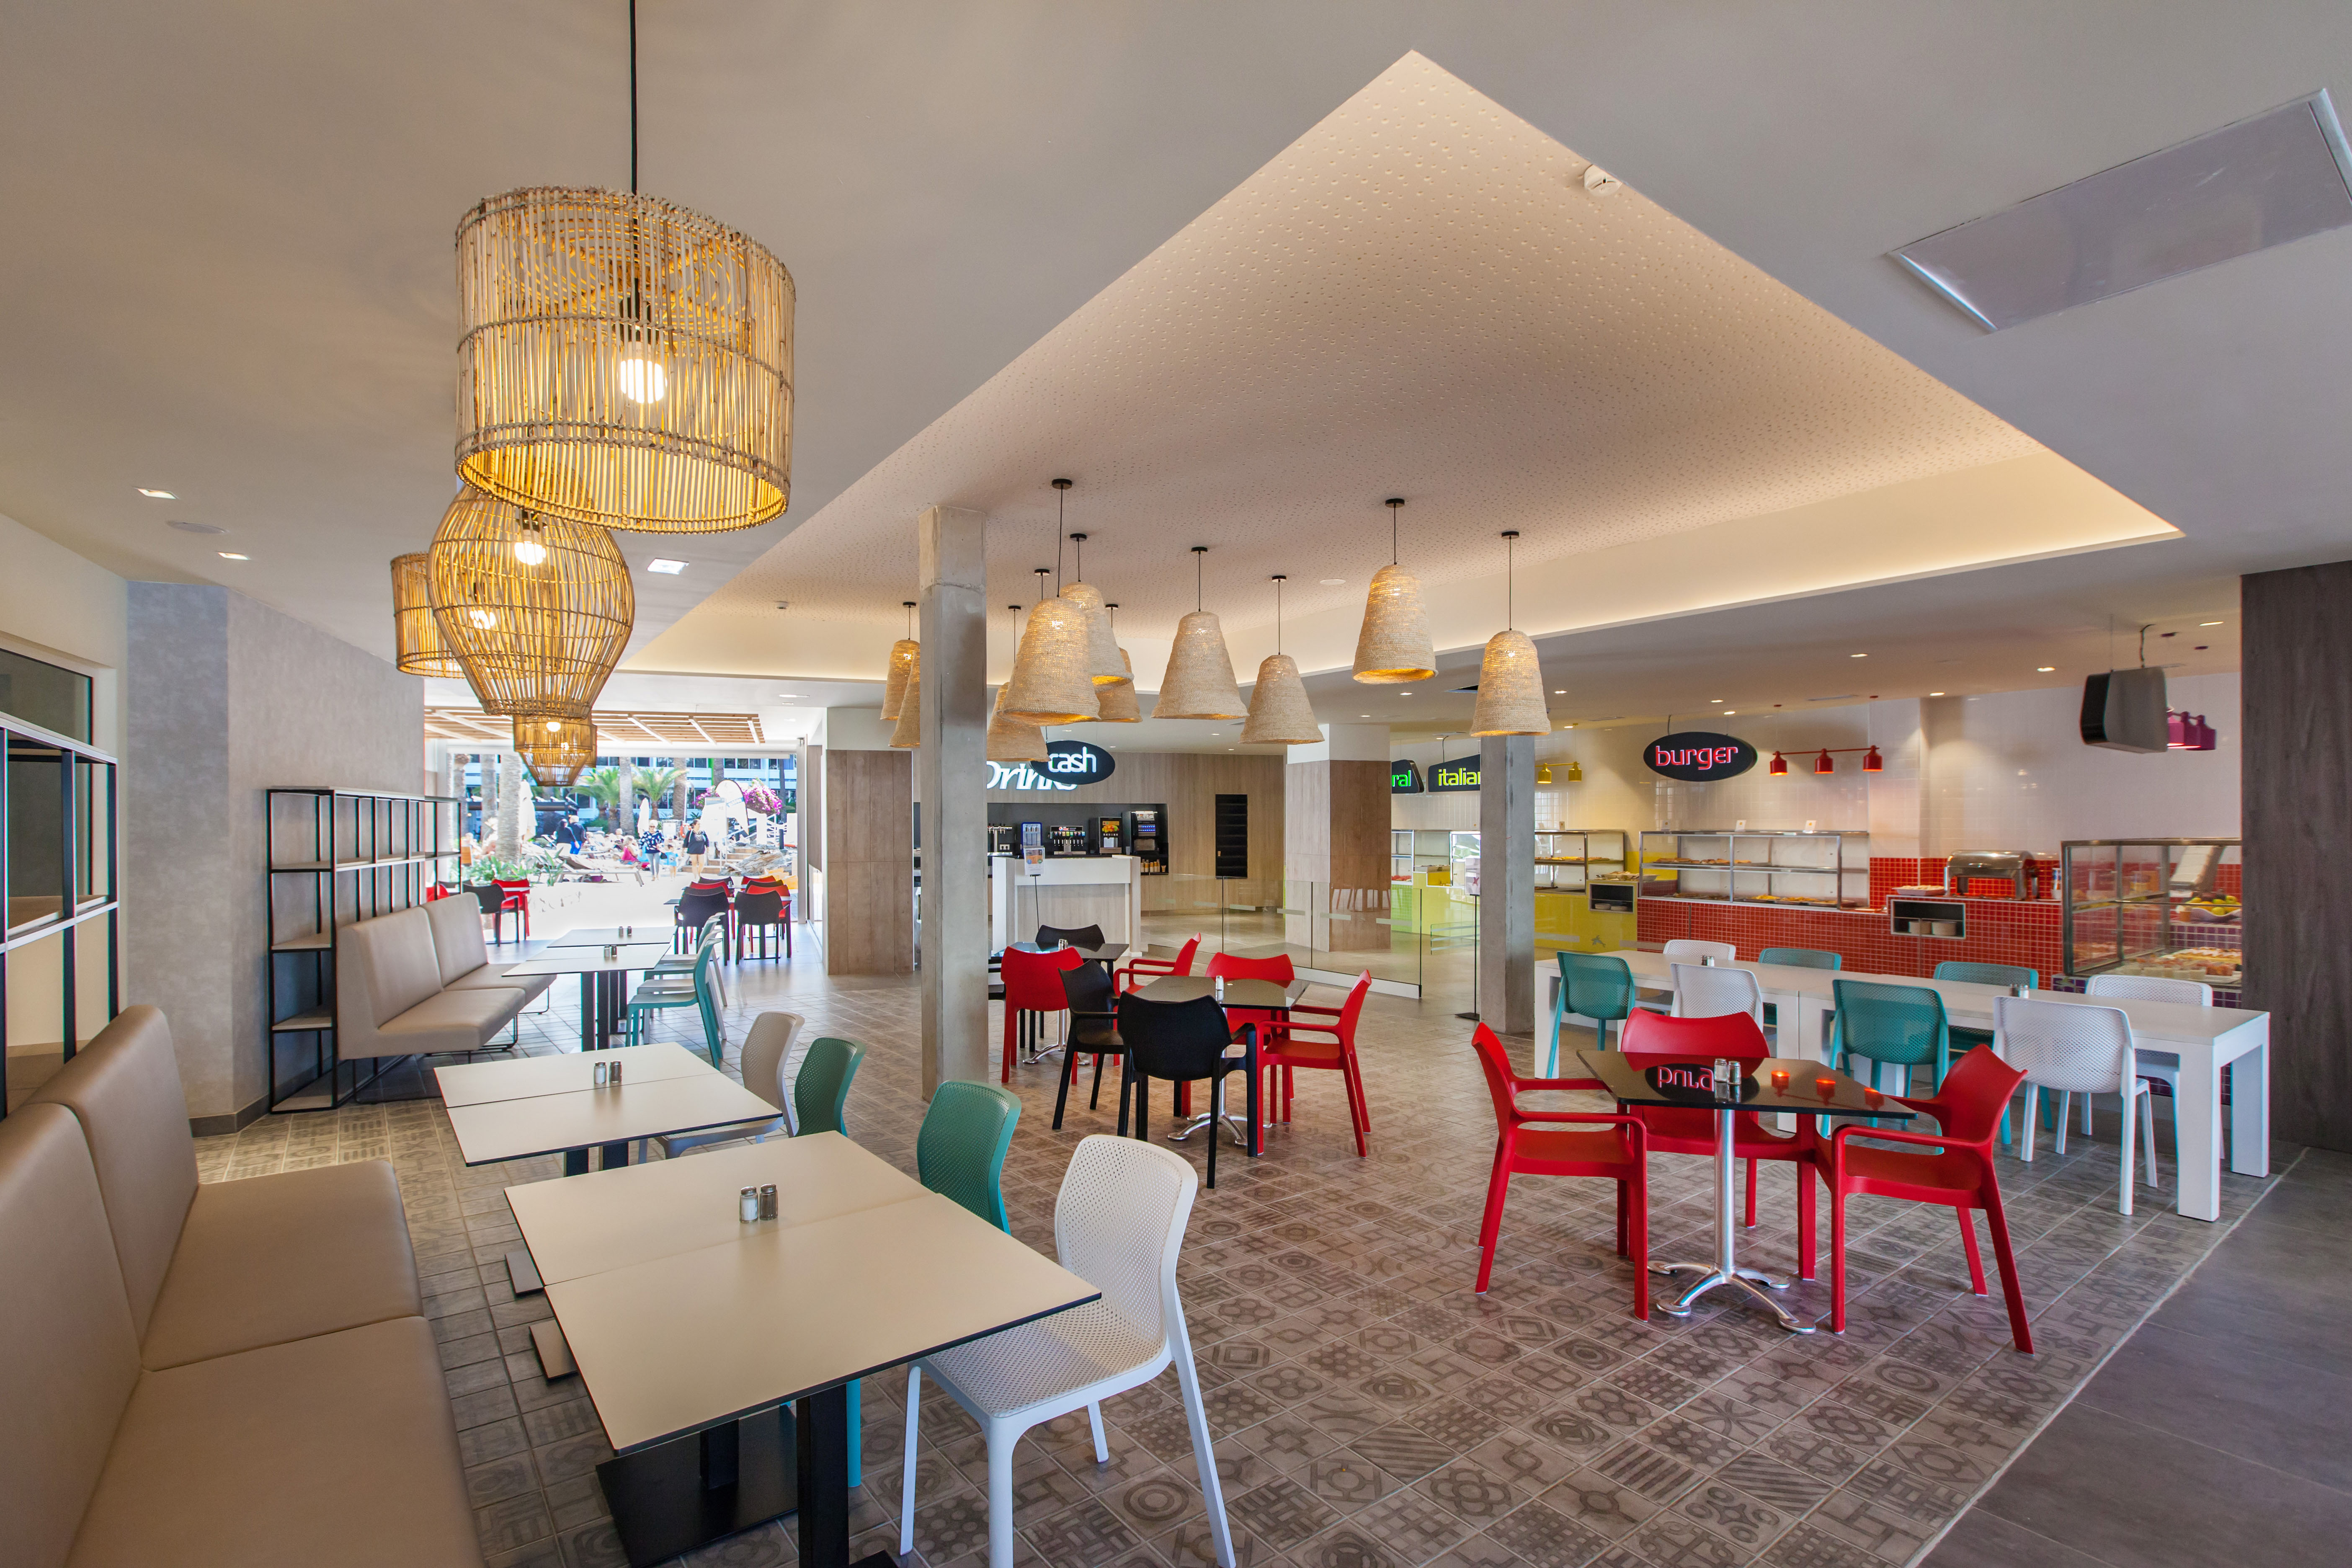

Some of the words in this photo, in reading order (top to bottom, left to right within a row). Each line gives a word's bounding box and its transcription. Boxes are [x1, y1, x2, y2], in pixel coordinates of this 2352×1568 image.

[1048, 746, 1097, 773] cash
[1656, 745, 1738, 770] burger
[1392, 770, 1411, 787] ral
[1438, 768, 1481, 786] italia
